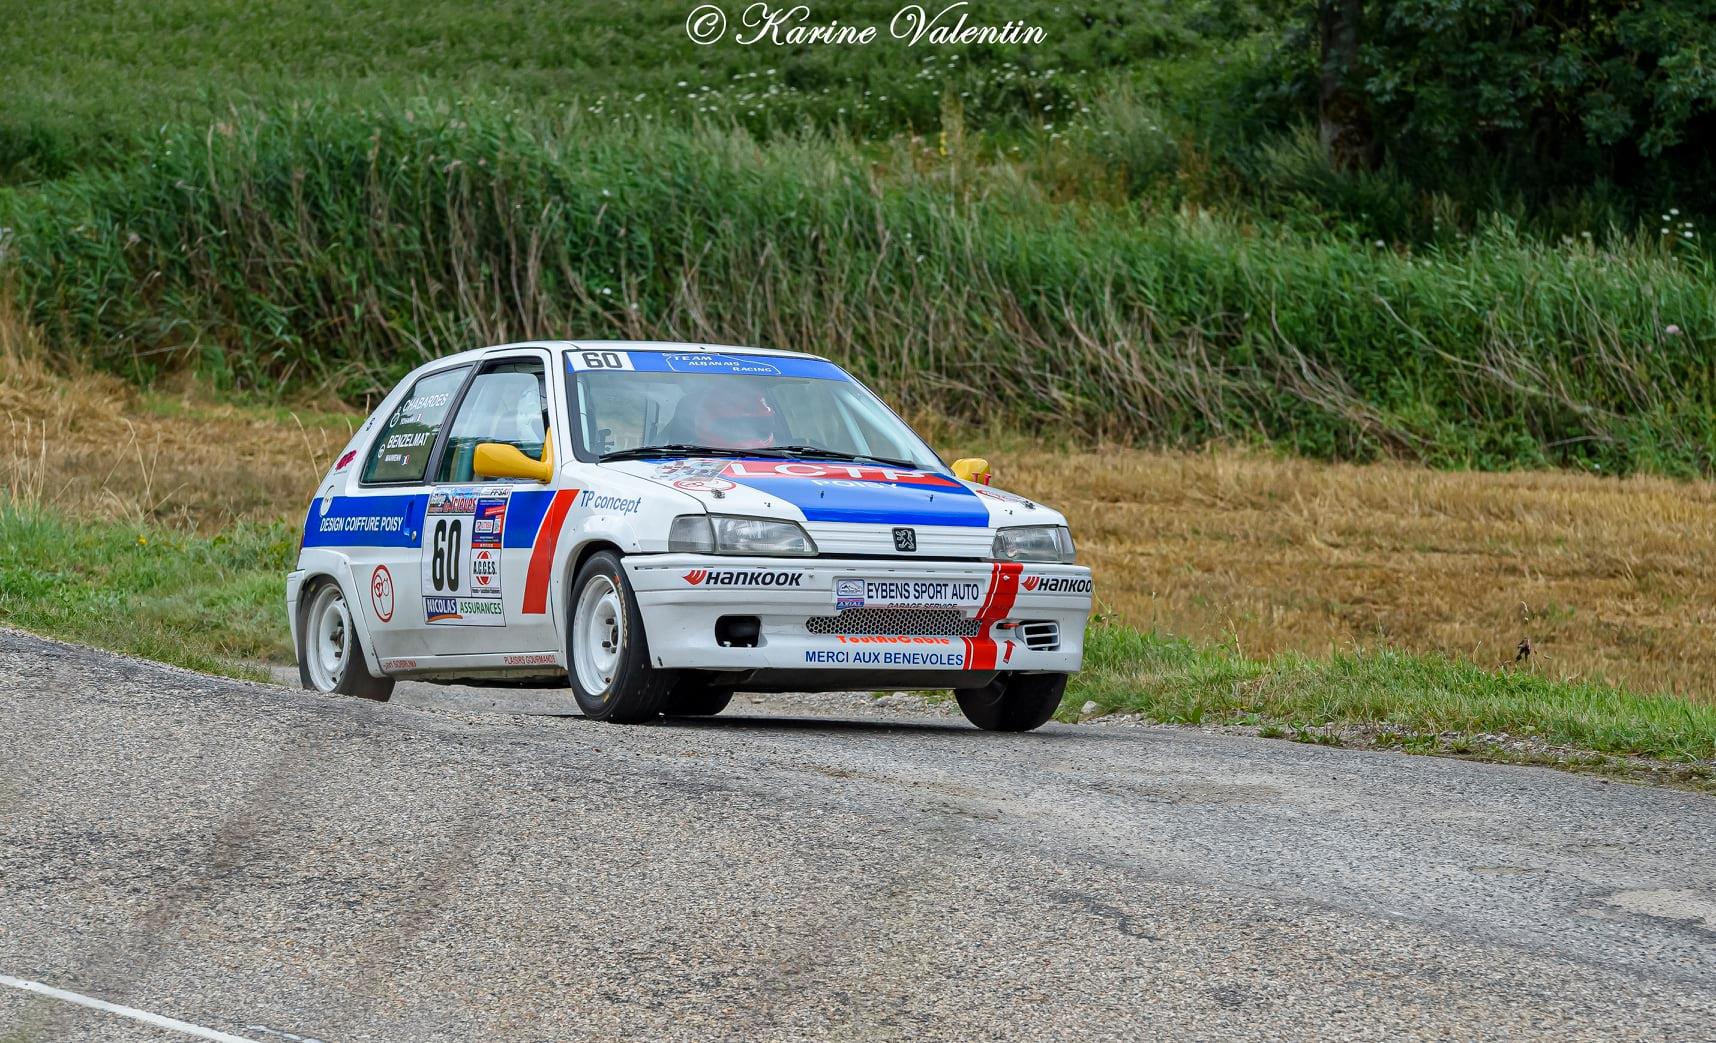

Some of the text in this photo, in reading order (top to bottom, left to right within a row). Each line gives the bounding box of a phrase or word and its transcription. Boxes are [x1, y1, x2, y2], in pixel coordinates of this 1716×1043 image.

[582, 352, 623, 369] 60
[386, 432, 430, 449] BENZELMAT
[730, 463, 925, 480] LCTP
[581, 490, 641, 516] TP concept
[320, 516, 403, 532] DESIGN COIFFURE POISY
[432, 519, 461, 592] 60
[867, 582, 979, 600] EYBENS SPORT AUTO
[426, 599, 502, 615] NICOLAS ASSURANCES
[805, 651, 963, 665] MERCI AUX BENEVOLES
